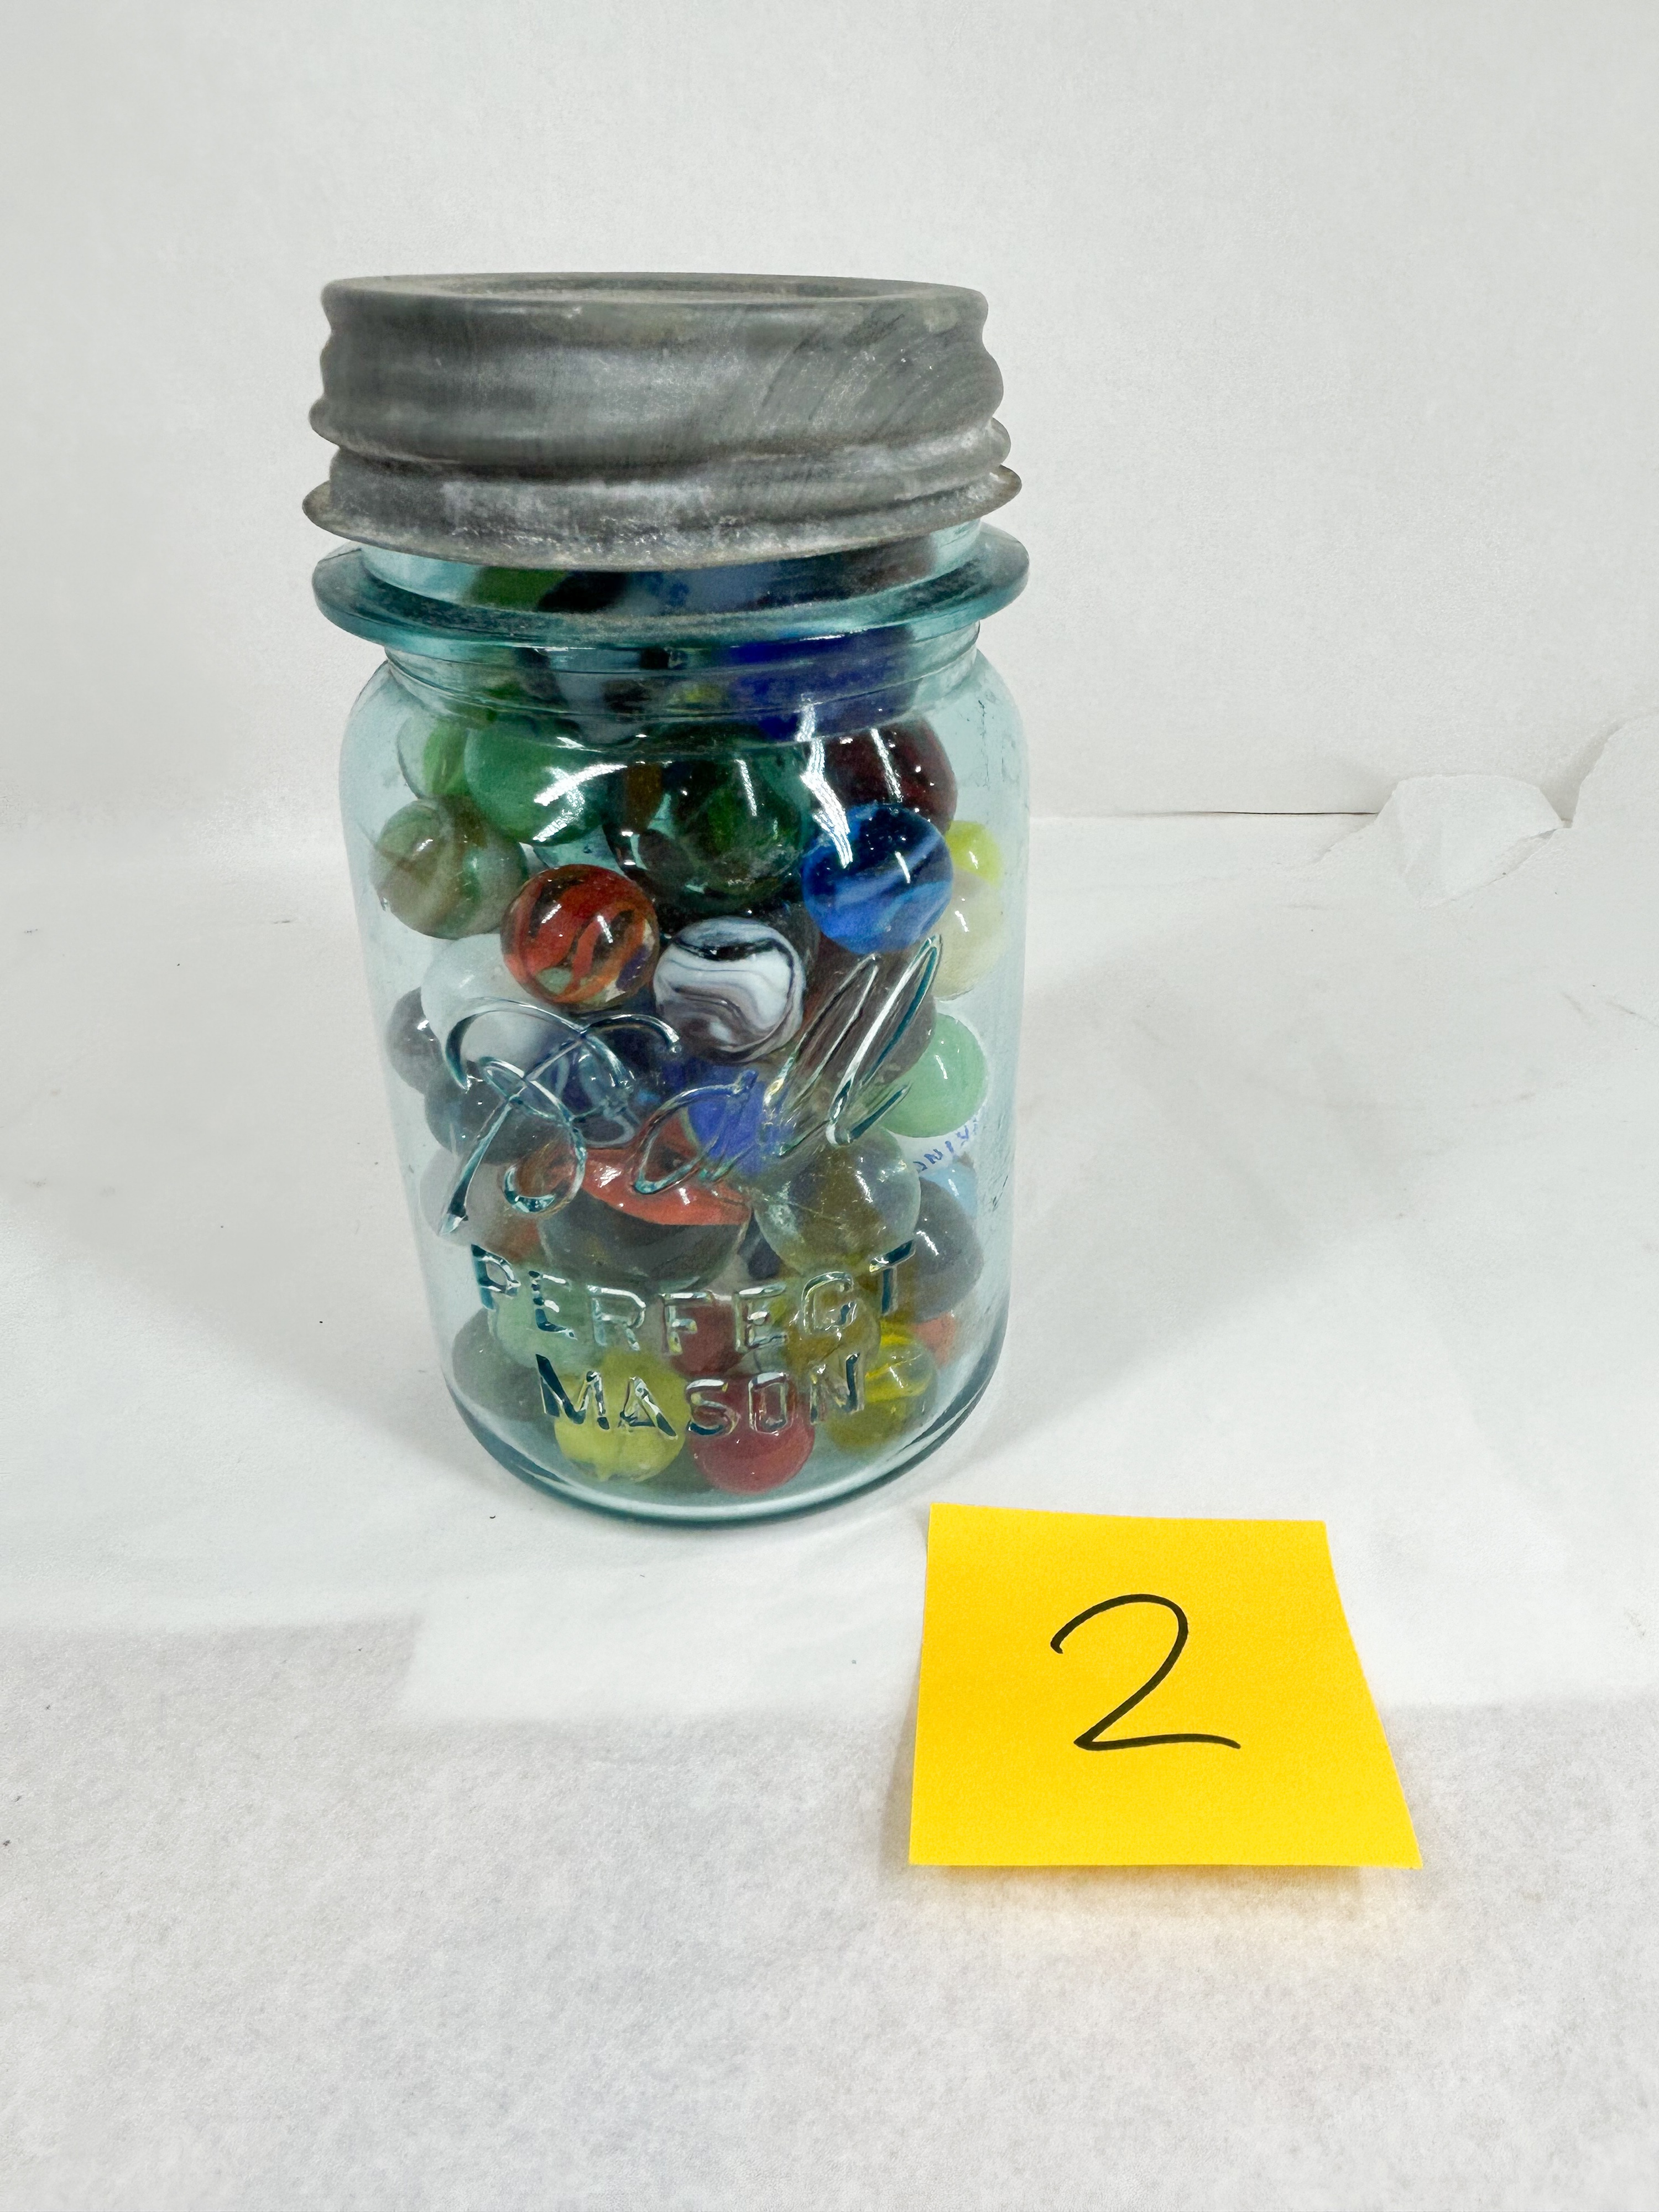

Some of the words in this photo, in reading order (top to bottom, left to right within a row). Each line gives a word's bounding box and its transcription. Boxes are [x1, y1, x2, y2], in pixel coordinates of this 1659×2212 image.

[442, 933, 943, 1234] Ball
[471, 1239, 916, 1353] PERFECT
[535, 1353, 866, 1439] MASON
[1050, 1593, 1241, 1751] 2
